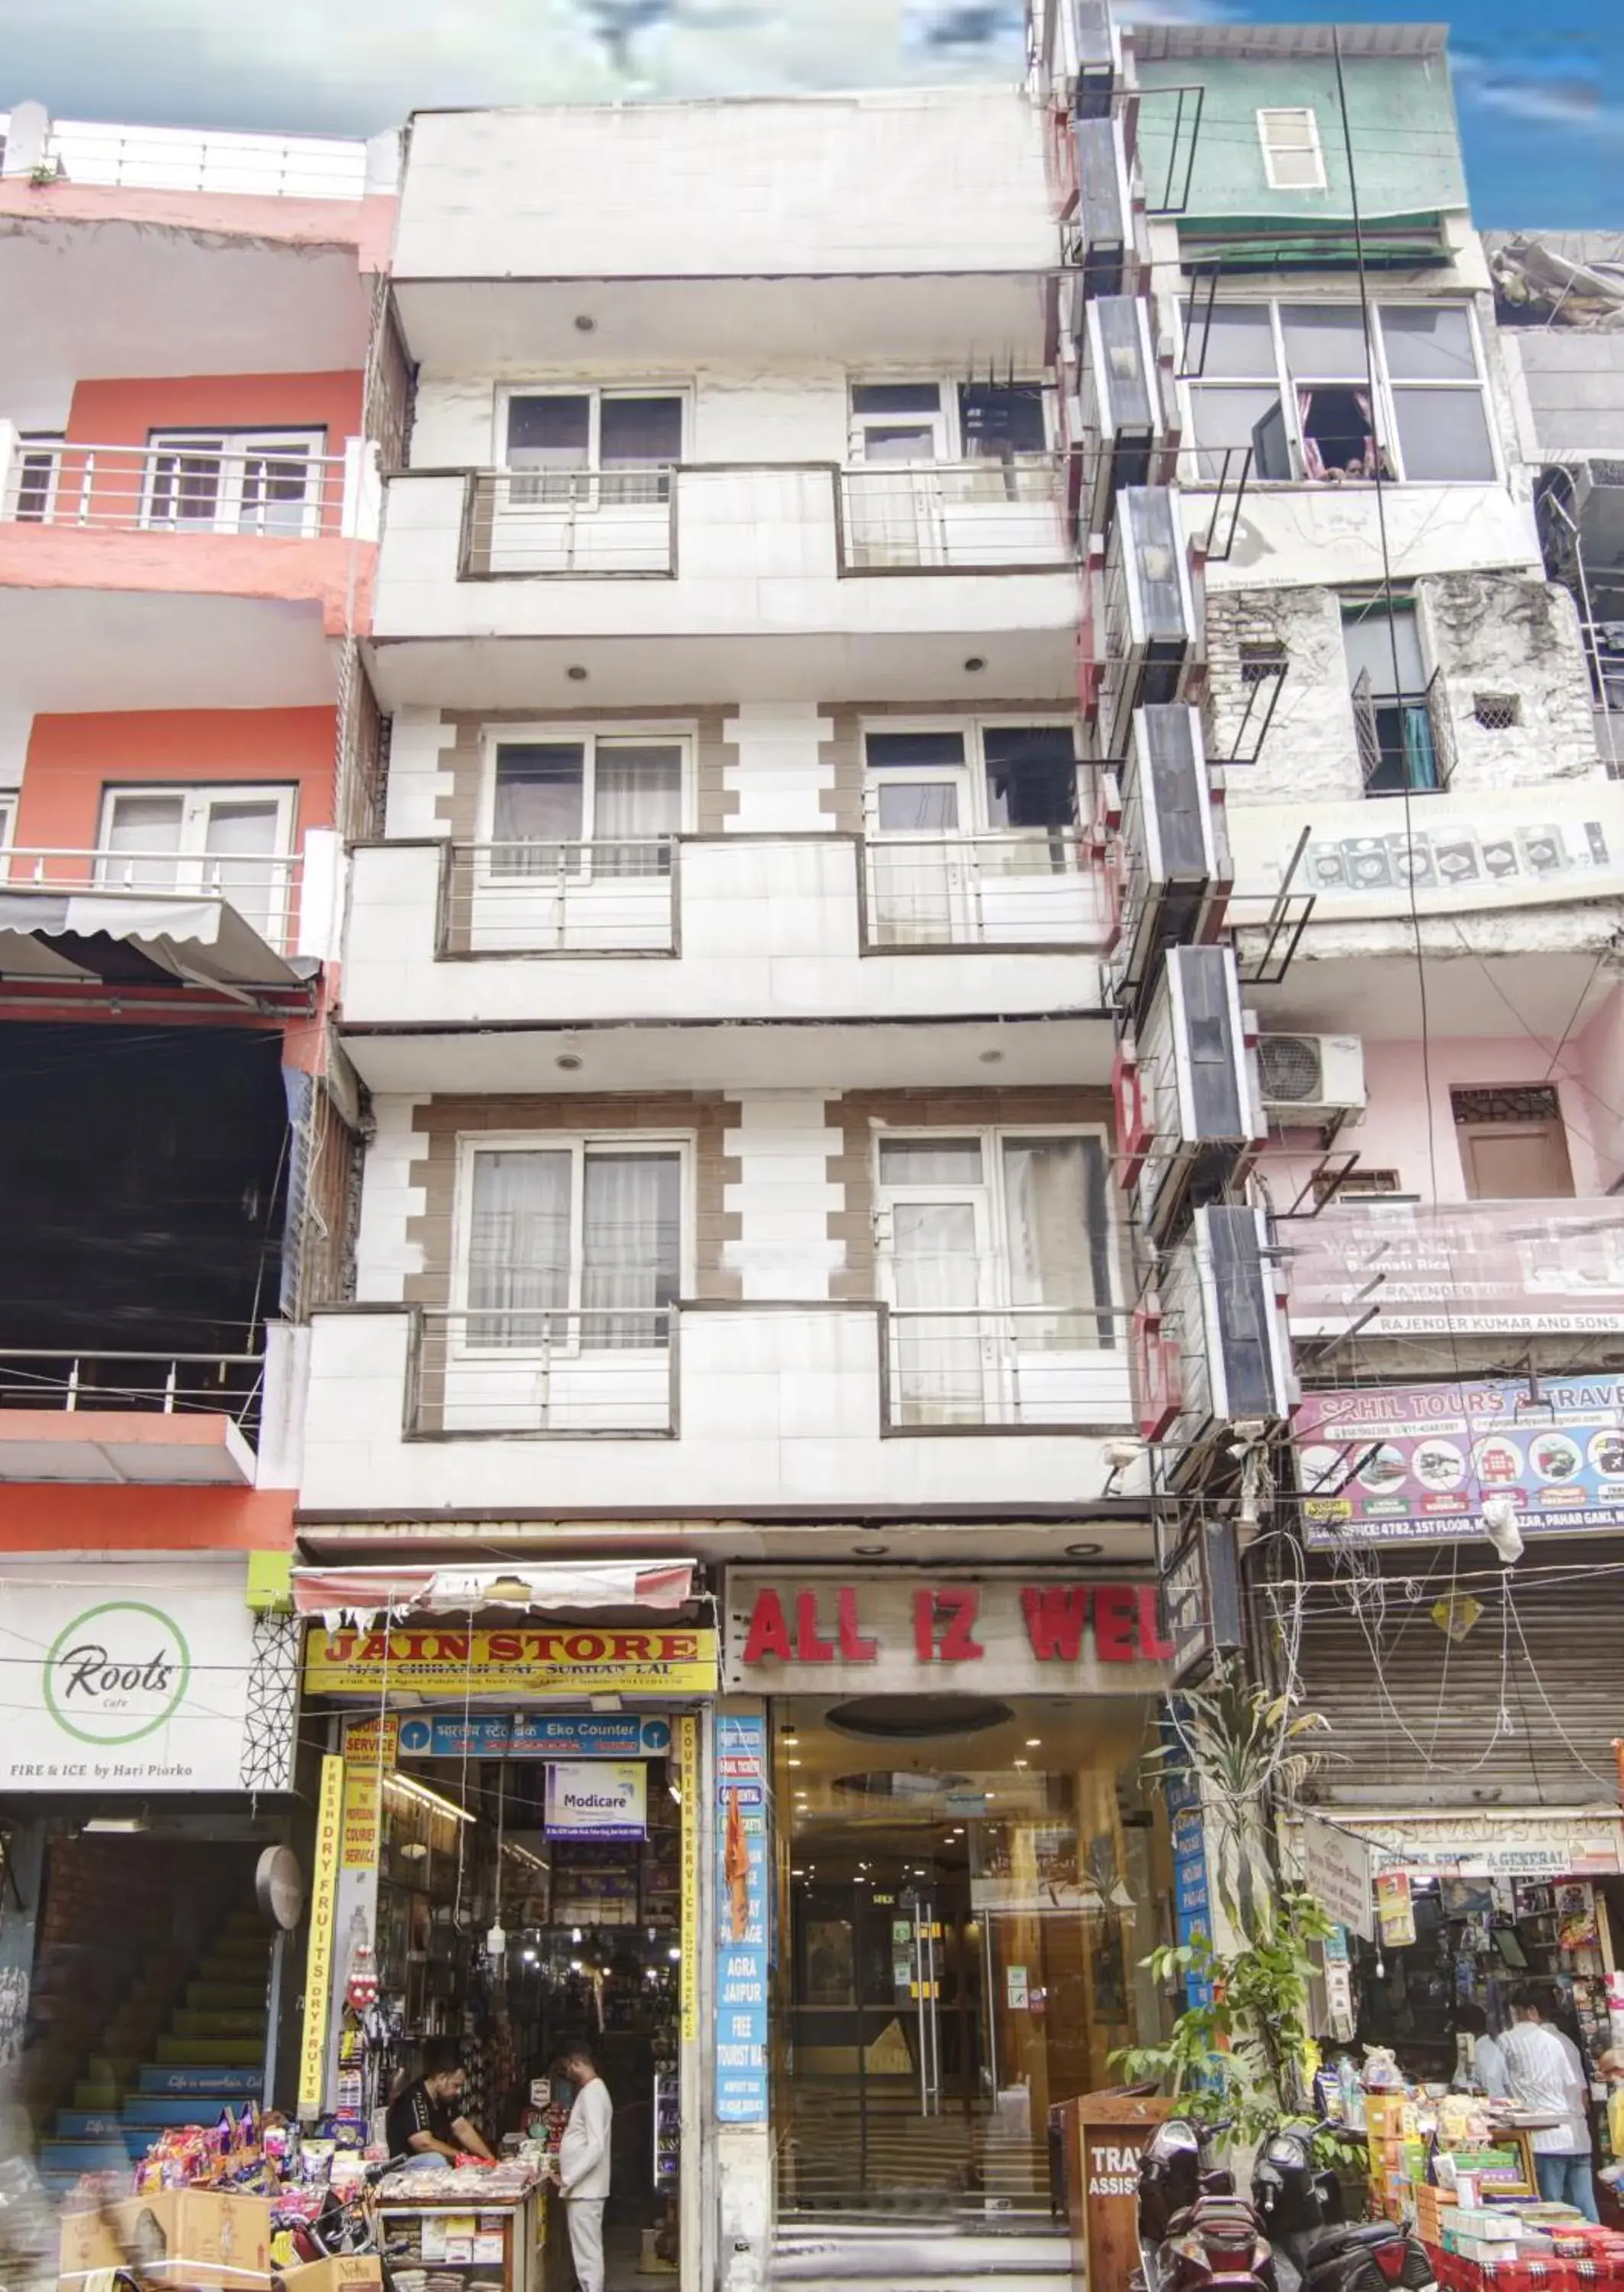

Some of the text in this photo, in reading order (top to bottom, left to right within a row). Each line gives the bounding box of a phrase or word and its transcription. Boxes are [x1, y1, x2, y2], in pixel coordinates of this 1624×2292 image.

[1380, 1316, 1619, 1331] RAJENDER KUMAR AND SONS
[1320, 1397, 1408, 1422] SAHIL
[1410, 1390, 1506, 1418] TOURS
[1381, 1523, 1414, 1536] 4782,
[1436, 1519, 1474, 1533] FLOOR,
[1546, 1512, 1583, 1526] PAHAR
[742, 1587, 877, 1663] ALL
[913, 1588, 984, 1663] IZ
[325, 1634, 698, 1662] JAIN STORE
[60, 1644, 174, 1699] Roots
[636, 1662, 673, 1675] LAL
[546, 1722, 636, 1737] Eko Counter
[346, 1738, 395, 1752] SERVICE
[10, 1764, 44, 1777] FIRE
[47, 1765, 60, 1777] &
[62, 1764, 87, 1777] ICE
[94, 1764, 111, 1779] by
[113, 1764, 145, 1777] Hari
[684, 1723, 694, 1816] COURIER
[564, 1794, 626, 1808] Modicare
[684, 1827, 694, 1922] SERVICE
[306, 1759, 338, 2099] FRESH DRY FRUITS DRY FRUITS
[726, 1957, 757, 1977] AGRA
[722, 1982, 762, 2003] JAIPUR
[732, 2015, 752, 2038] FREE
[717, 2044, 749, 2067] TOURIST
